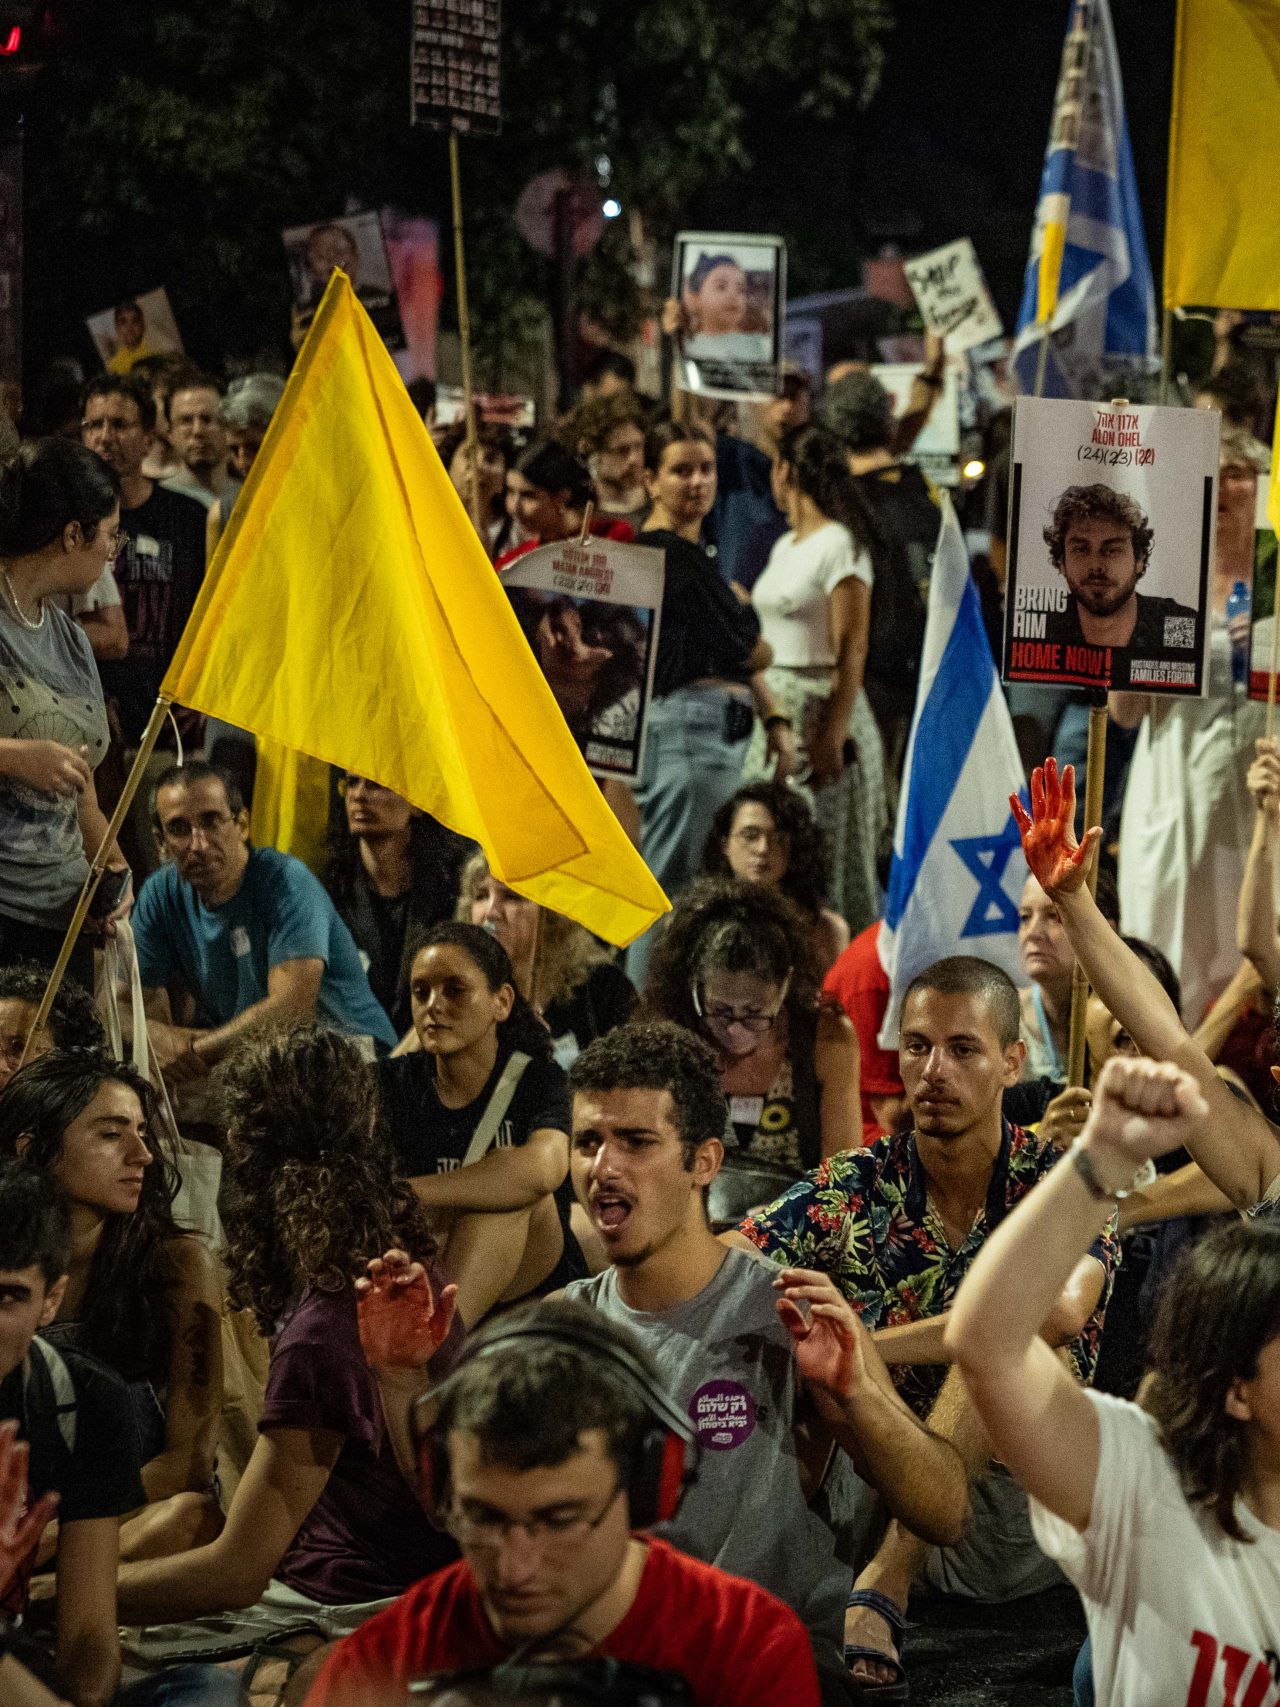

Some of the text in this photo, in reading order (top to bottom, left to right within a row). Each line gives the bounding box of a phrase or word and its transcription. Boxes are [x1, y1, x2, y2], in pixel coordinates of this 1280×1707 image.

[1097, 411, 1139, 431] אלון אהל
[1092, 428, 1141, 447] ALON OHEL
[1014, 586, 1068, 613] BRING
[1012, 611, 1047, 639] HIM
[1011, 641, 1112, 677] HOME NOW!
[1130, 669, 1196, 684] FAMILIES FORUM
[697, 1401, 747, 1414] רק שלום
